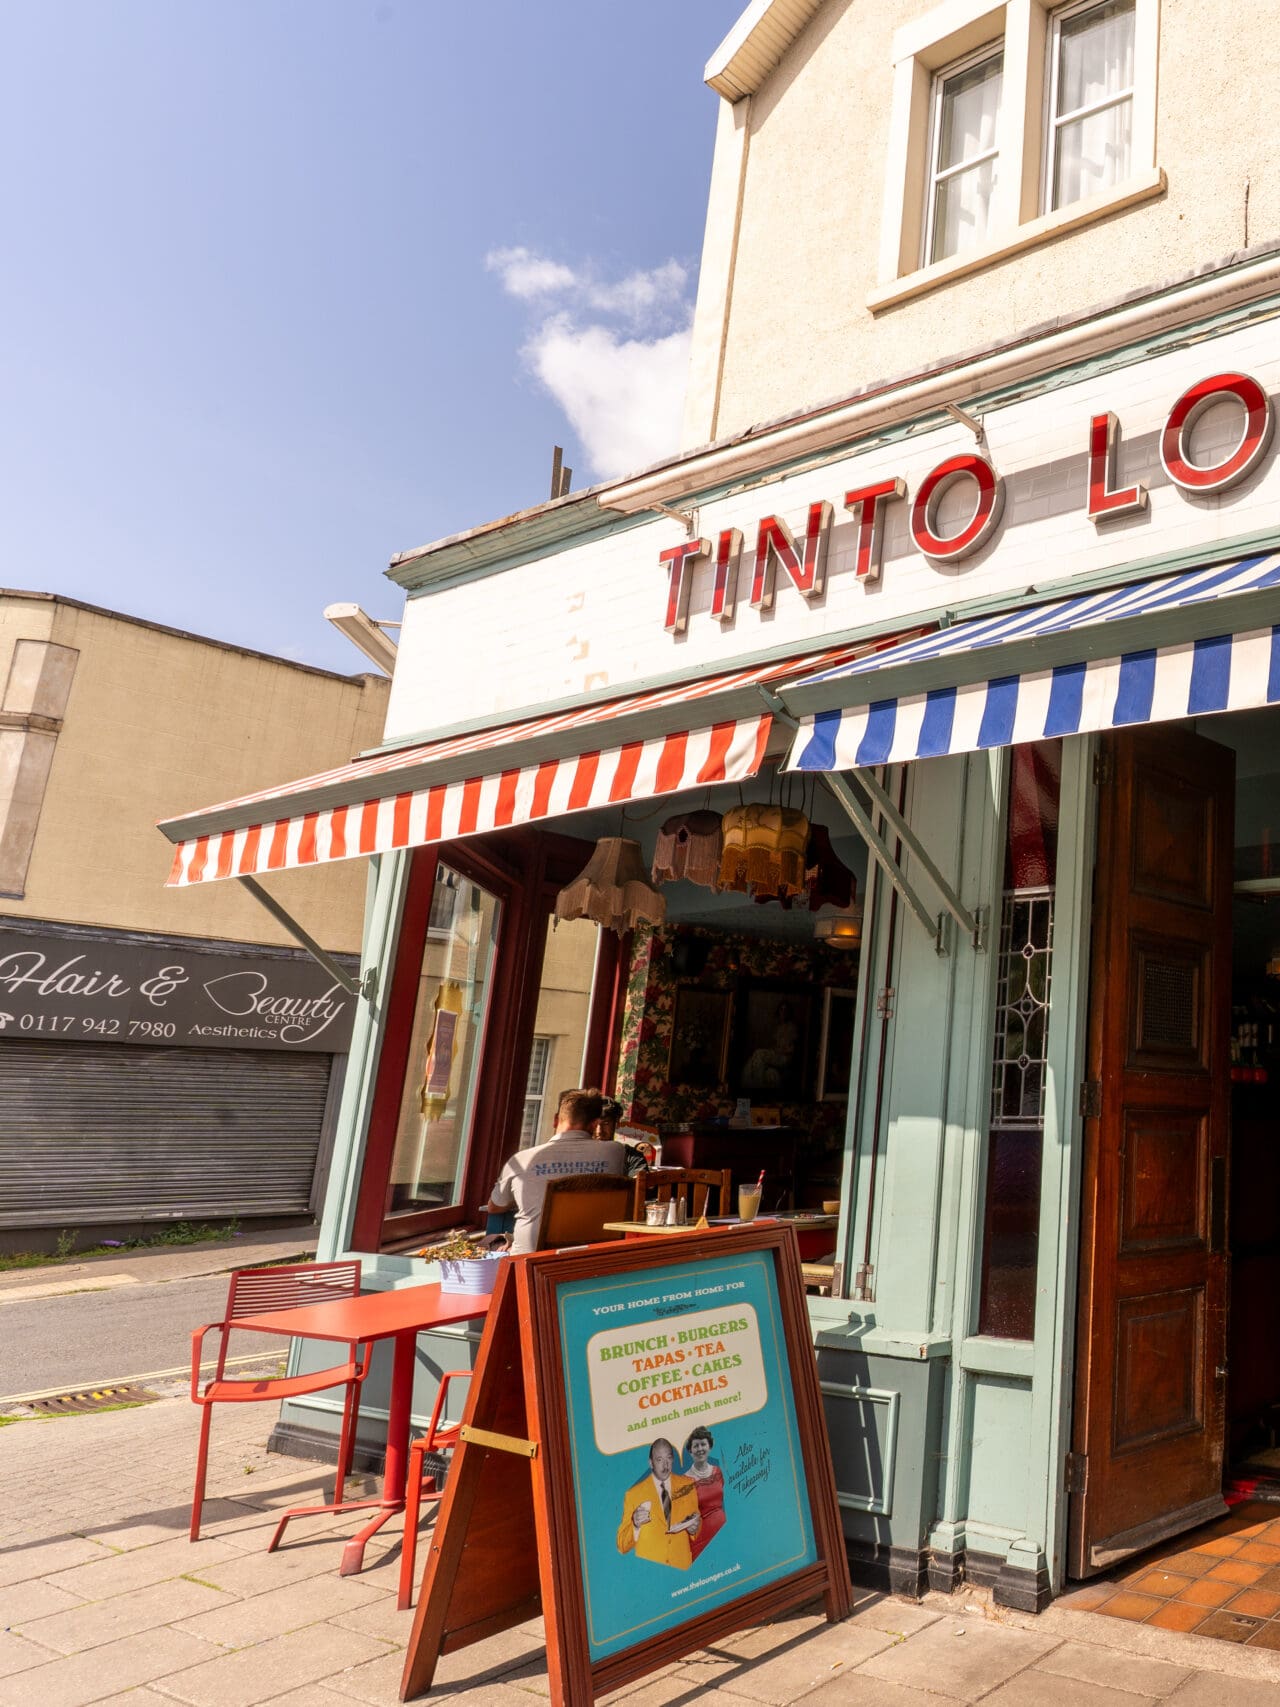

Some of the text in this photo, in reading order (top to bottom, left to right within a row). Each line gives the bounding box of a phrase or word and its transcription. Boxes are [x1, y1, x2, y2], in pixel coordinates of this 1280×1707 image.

[659, 453, 1006, 634] TINTO
[0, 951, 345, 1043] Hair & Beauty
[19, 1014, 278, 1040] 0117 942 7980 Aesthetics
[265, 1014, 312, 1027] CENTRE
[592, 1303, 625, 1316] YOUR
[627, 1297, 660, 1310] HOME
[662, 1290, 692, 1303] FROM
[695, 1285, 724, 1297] HOME
[726, 1281, 746, 1292] FOR
[600, 1317, 749, 1362] BRUNCH BURGERS
[632, 1341, 726, 1373] TAPAS TEA
[617, 1354, 743, 1396] COFFEE CAKES
[638, 1375, 729, 1410] COCKTAILS
[627, 1392, 743, 1433] and much much more!
[671, 1563, 742, 1598] www.thelounges.co.uk
